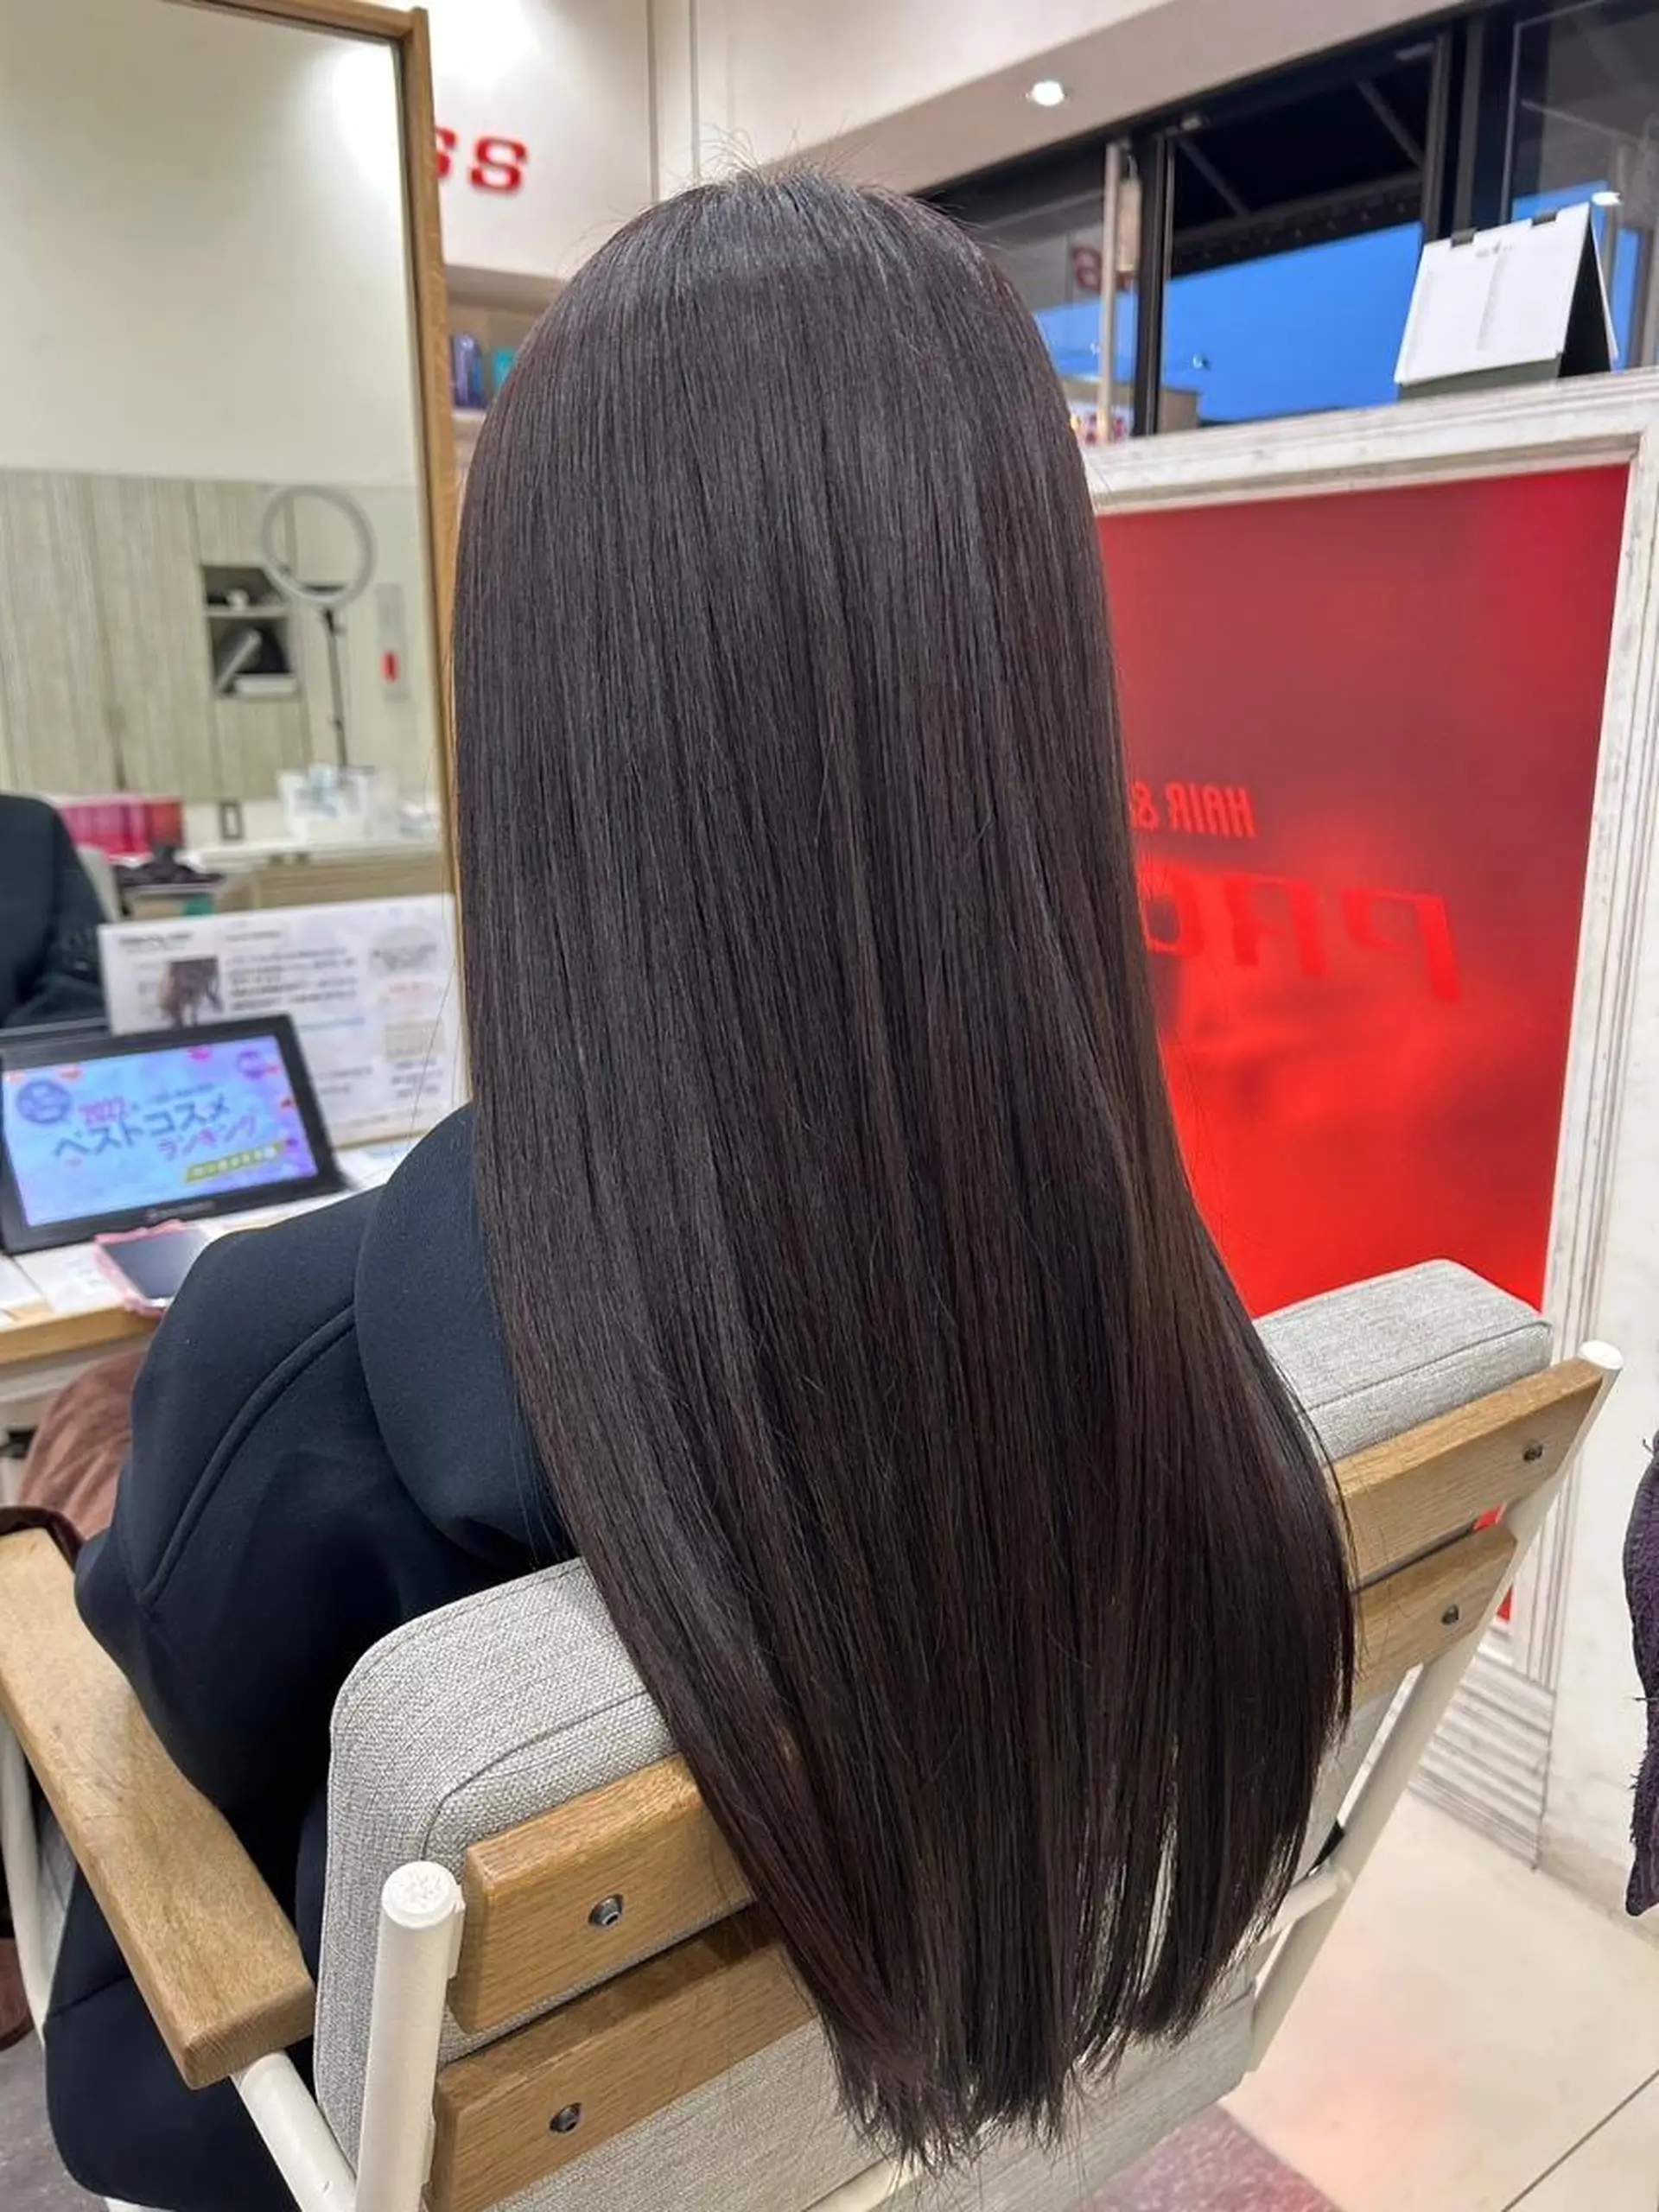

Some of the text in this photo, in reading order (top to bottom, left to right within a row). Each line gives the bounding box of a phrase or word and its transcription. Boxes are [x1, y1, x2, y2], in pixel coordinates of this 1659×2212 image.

[53, 1094, 231, 1158] ベストコスメ
